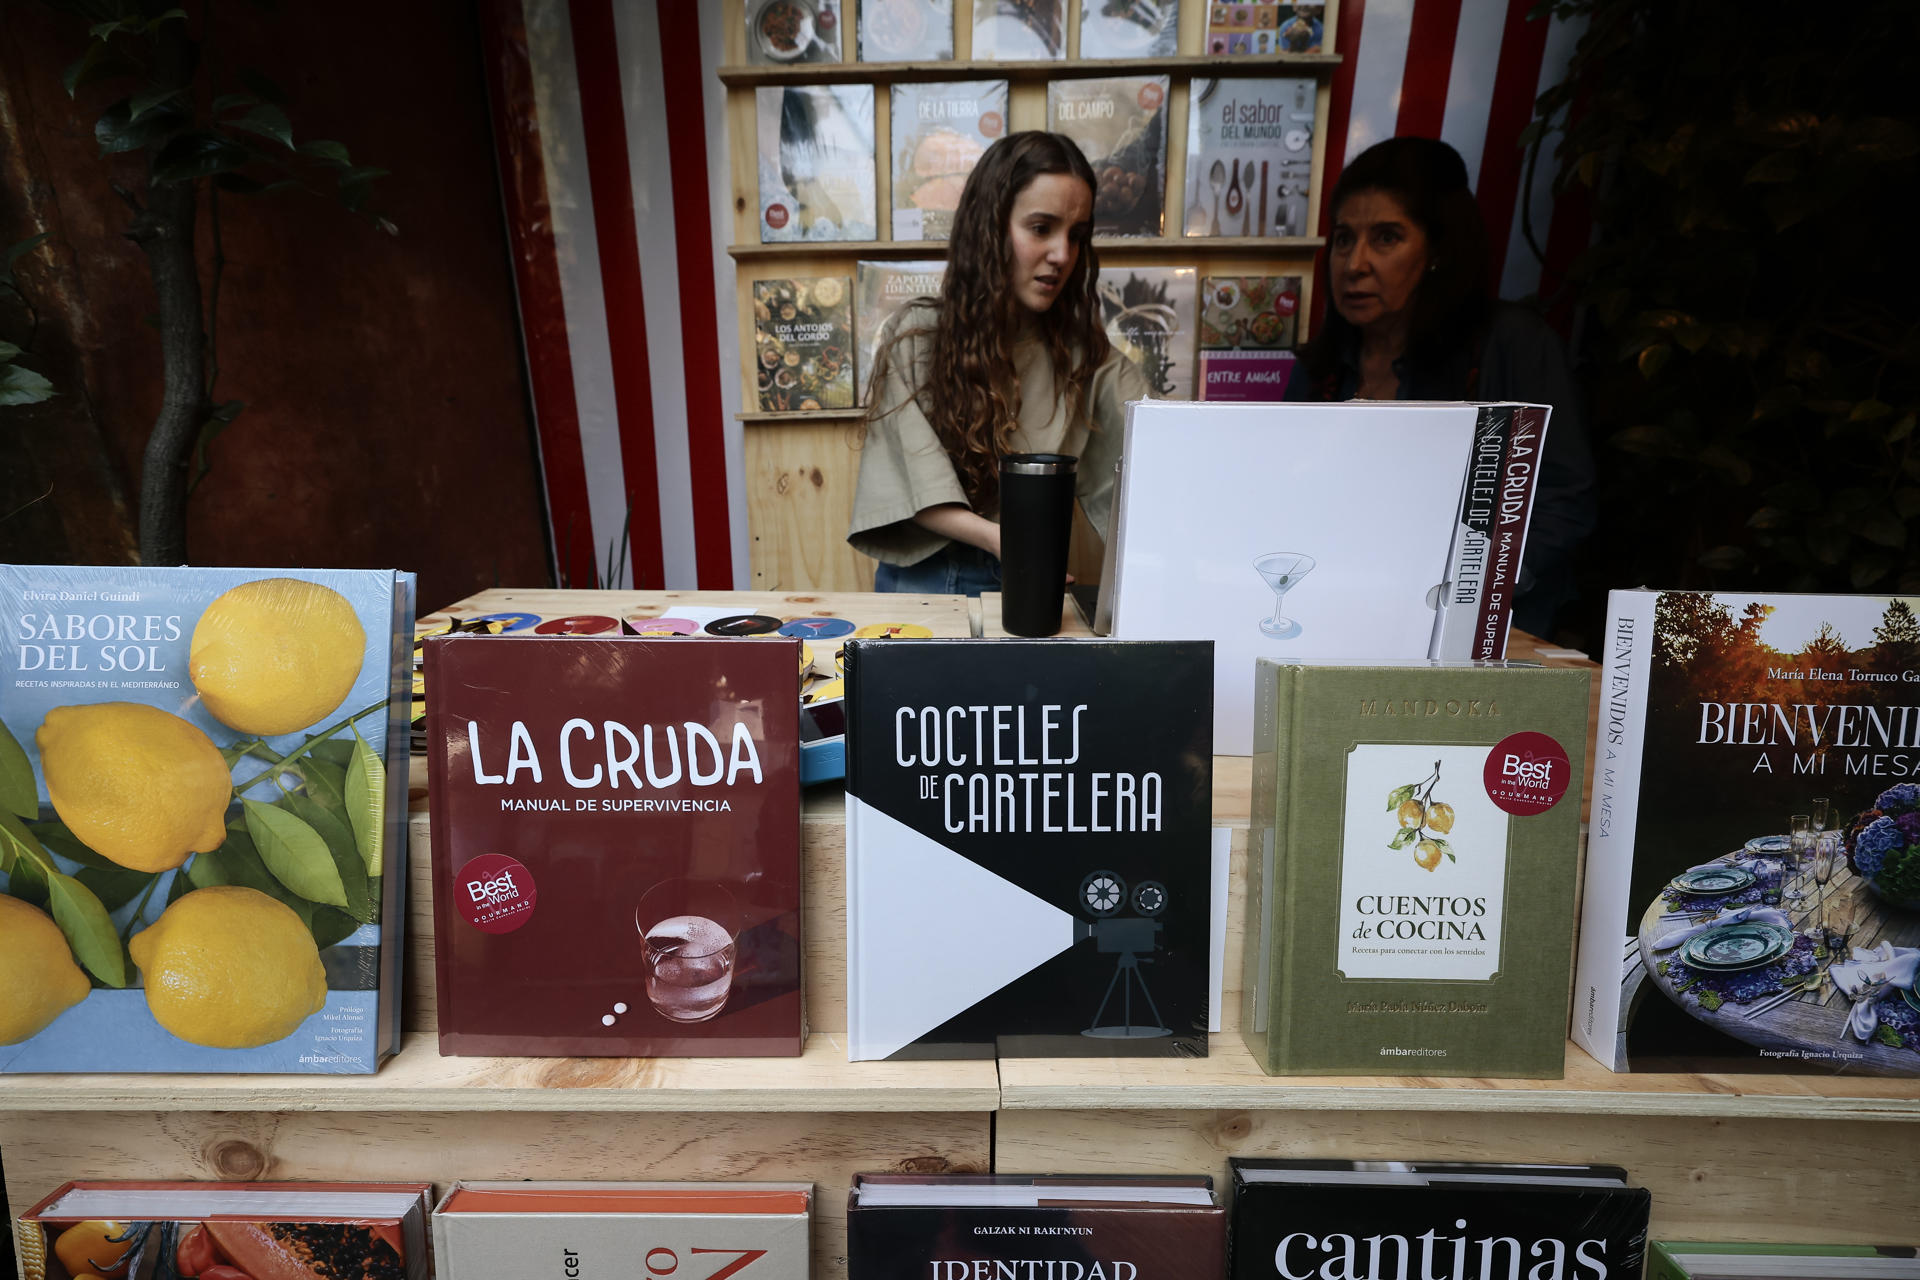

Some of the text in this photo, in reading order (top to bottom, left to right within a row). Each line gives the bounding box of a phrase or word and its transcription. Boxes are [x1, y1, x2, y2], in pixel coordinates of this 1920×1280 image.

[918, 100, 979, 120] DE LA TIERRA
[1058, 100, 1115, 120] DEL CAMPO
[1222, 97, 1284, 124] el sabor
[1221, 125, 1282, 139] DEL MUNDO
[885, 284, 942, 294] IDENTITY
[775, 322, 834, 333] LOS ANTOJOS
[779, 332, 831, 342] DEL GORDO
[1207, 370, 1281, 384] ENTRE AMIGAS
[1511, 433, 1536, 458] LA
[1500, 462, 1531, 525] CRUDA
[1455, 434, 1502, 605] COCTELES DE CARTELERA
[1492, 532, 1513, 590] MANUAL
[23, 590, 140, 602] Elvira Daniel Guindi
[1488, 593, 1501, 611] DE
[18, 613, 182, 642] SABORES
[17, 644, 166, 672] DEL SOL
[1767, 667, 1805, 680] María
[1808, 668, 1844, 681] Elena
[1847, 668, 1899, 682] Torruco
[15, 680, 180, 690] RECETAS INSPIRADAS EN EL MEDITERRÁNEO
[1359, 699, 1503, 718] MANDOKA
[895, 703, 1088, 767] COCTELES
[1598, 616, 1635, 839] BIENVENIDOS A MI MESA
[467, 717, 763, 789] LA CRUDA
[1502, 753, 1553, 781] Best
[1752, 752, 1773, 774] A
[1793, 753, 1826, 775] MI
[1517, 775, 1549, 790] World
[919, 772, 1162, 834] DE CARTELERA
[1492, 789, 1553, 802] GOURMAND
[500, 799, 732, 813] MANUAL DE SUPERVIVENCIA
[466, 870, 517, 902] Best
[488, 888, 520, 905] World
[1356, 895, 1487, 918] CUENTOS
[473, 900, 530, 923] GOURMAND
[1352, 919, 1487, 941] de COCINA
[1351, 946, 1379, 955] Recetas
[1380, 947, 1396, 956] para
[1397, 947, 1428, 955] conectar
[1444, 947, 1455, 956] los
[1456, 947, 1486, 956] sentidos
[1379, 1046, 1447, 1057] ámbareditores
[1801, 1050, 1831, 1060] Ignacio
[1832, 1050, 1864, 1061] Urquiza
[973, 1225, 1094, 1237] GALZAK NI RAKI'NYUN
[1274, 1218, 1609, 1280] cantinas
[563, 1248, 580, 1280] cer
[929, 1259, 1138, 1280] IDENTIDAD
